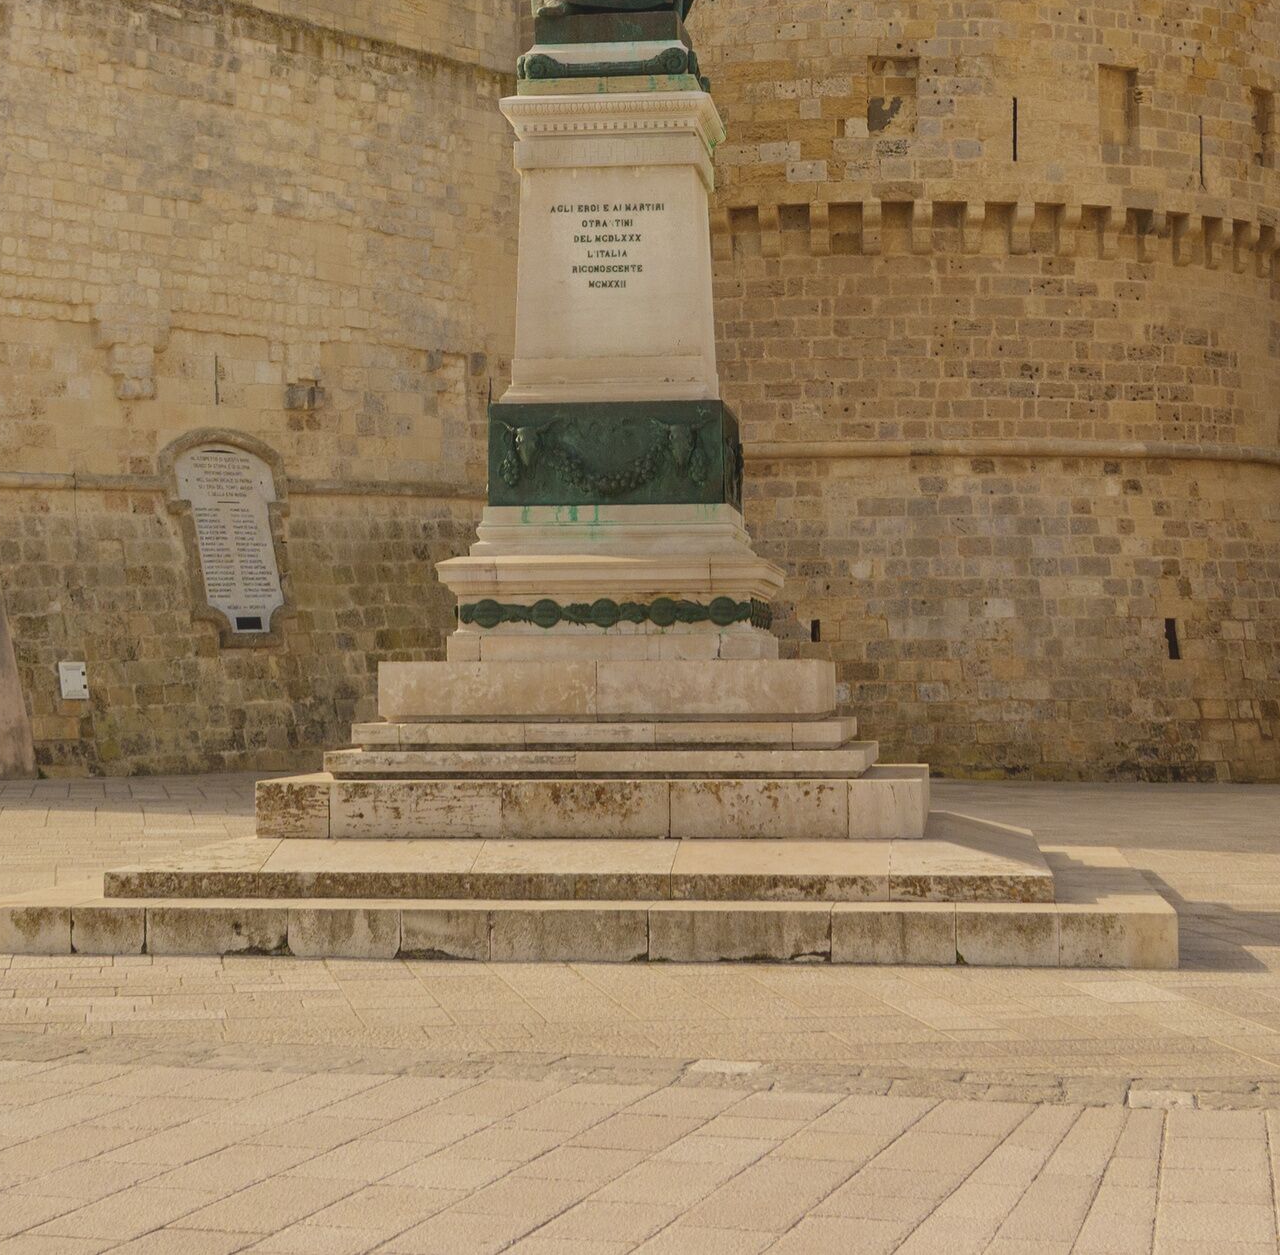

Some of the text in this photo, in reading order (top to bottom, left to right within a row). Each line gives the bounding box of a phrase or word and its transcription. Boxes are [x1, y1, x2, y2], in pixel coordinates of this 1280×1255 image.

[550, 203, 665, 213] AGLI EROI E AI MARTIRI
[581, 219, 633, 228] OTRATINI
[573, 233, 642, 243] DEL MCDLXXX
[572, 264, 643, 274] RICONOSCENTE
[588, 279, 627, 289] MCMXXII
